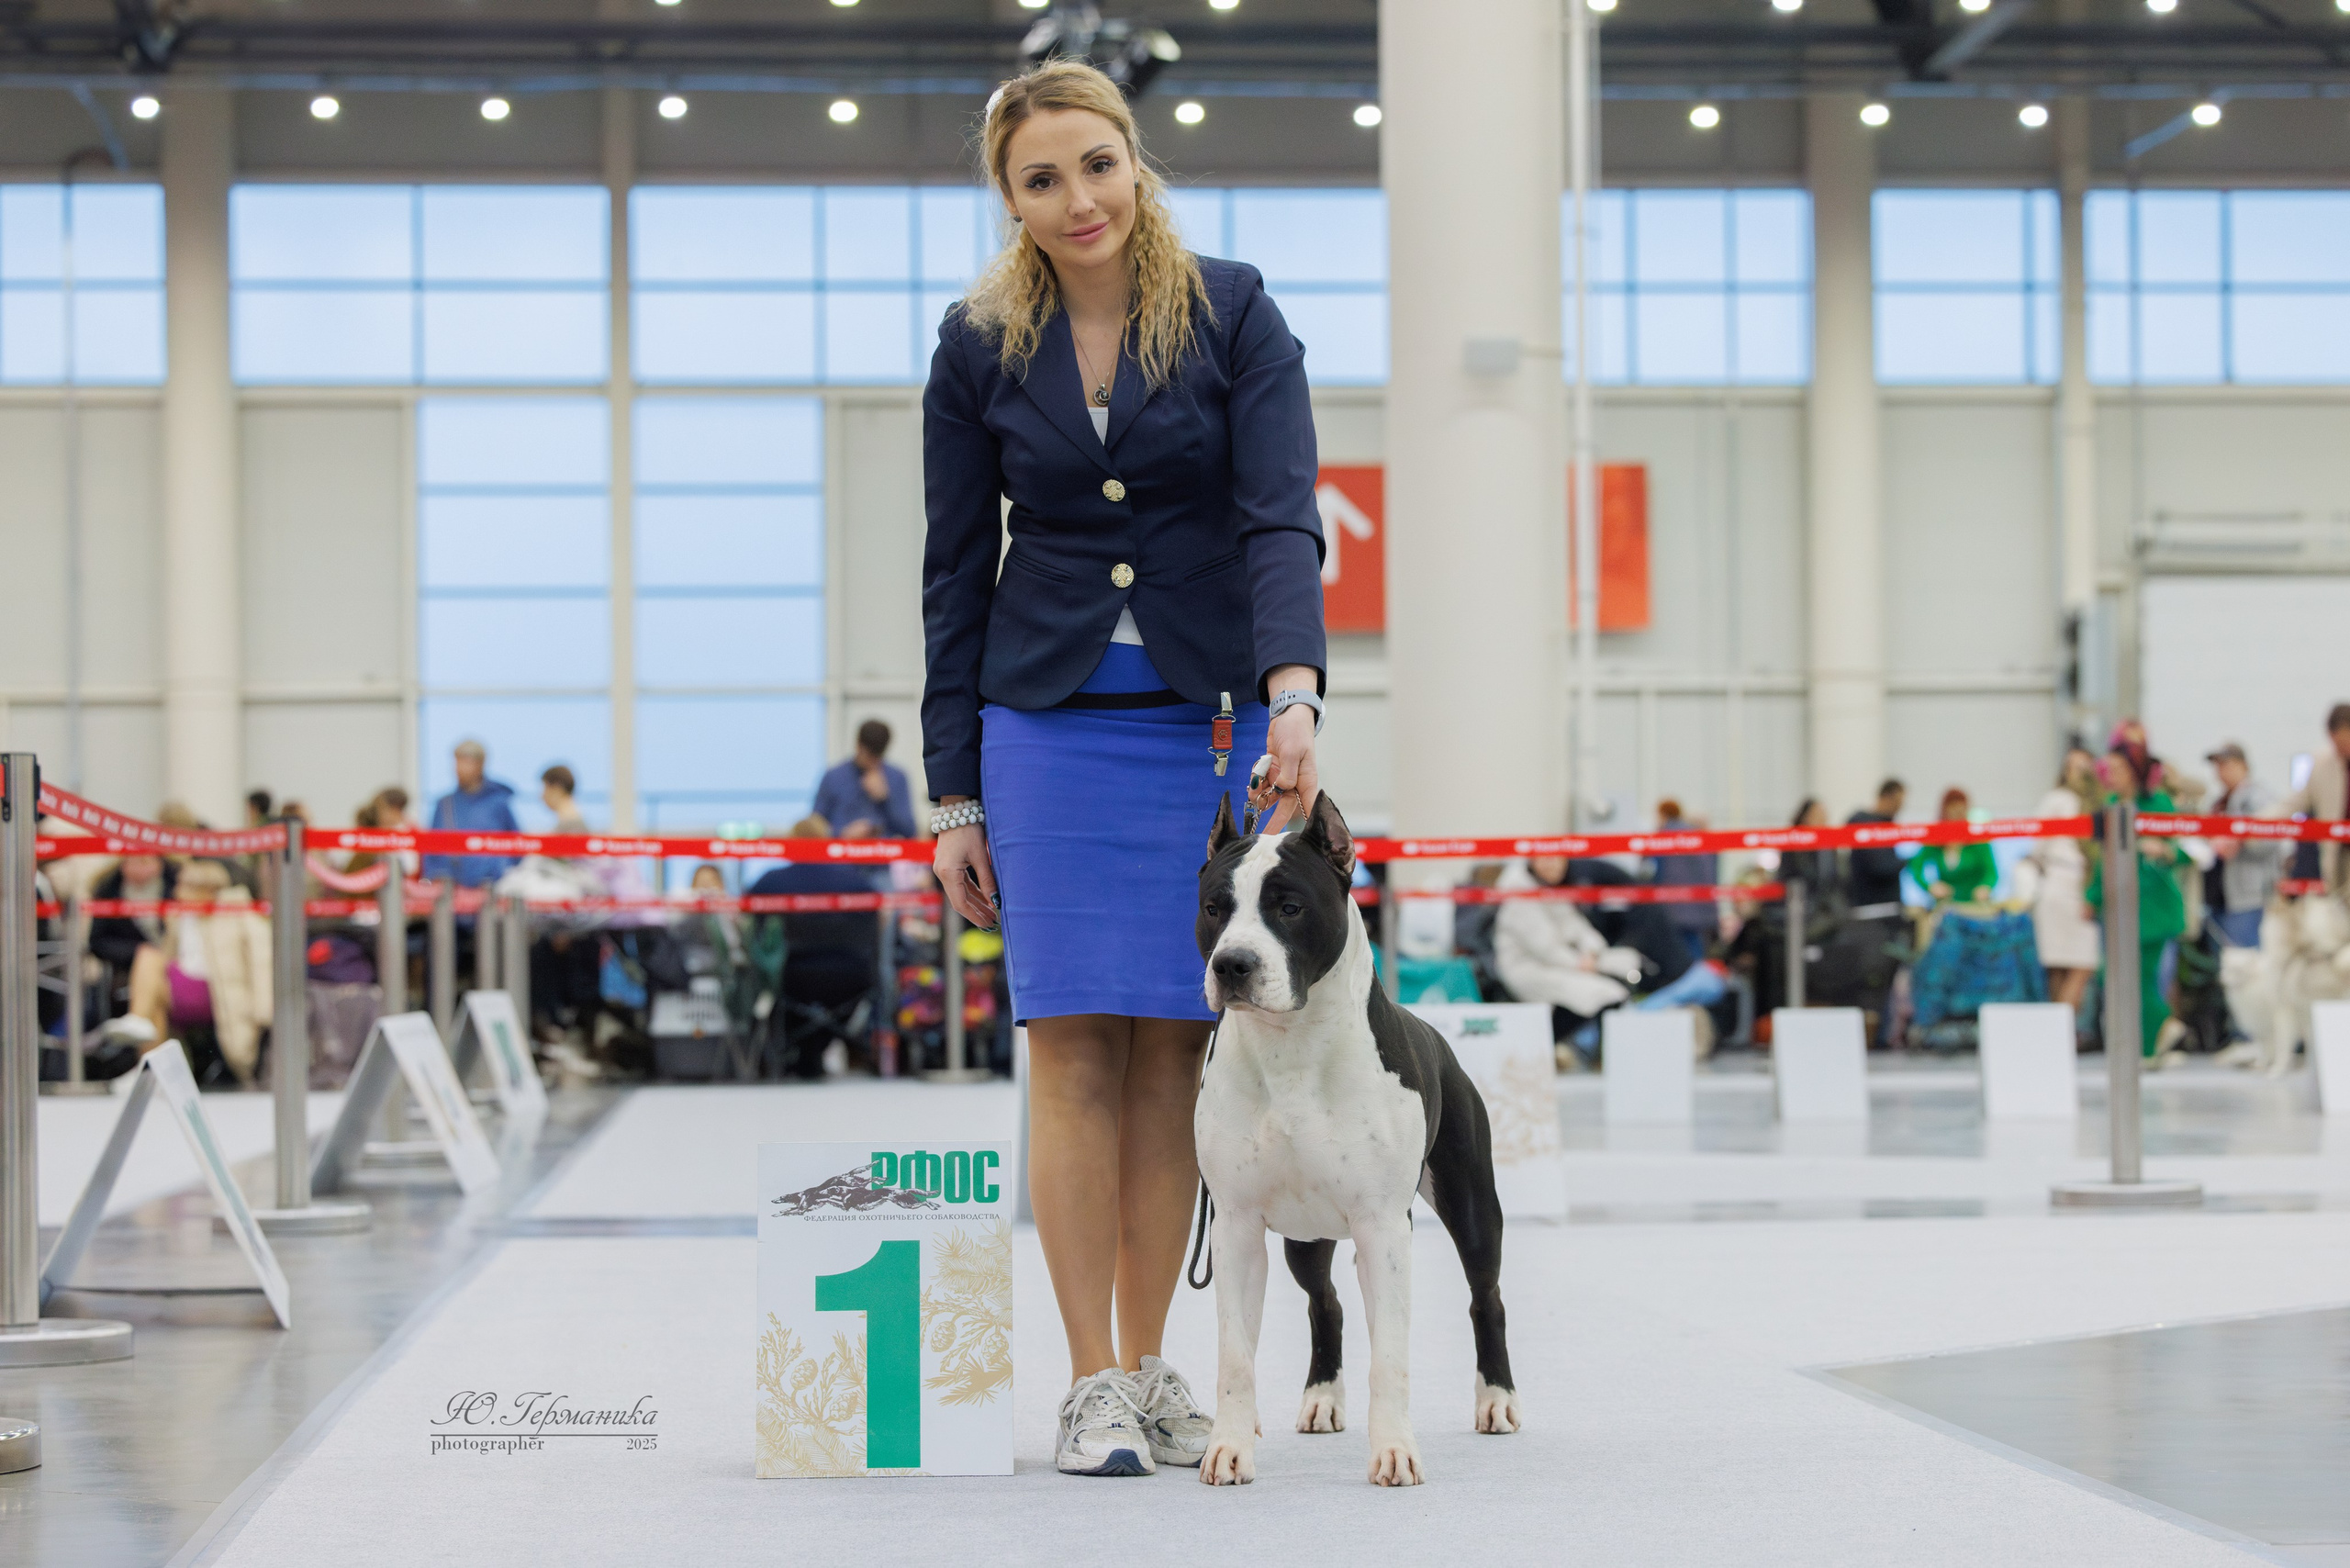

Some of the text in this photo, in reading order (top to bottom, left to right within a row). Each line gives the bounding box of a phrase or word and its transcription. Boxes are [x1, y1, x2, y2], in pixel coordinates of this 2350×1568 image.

[871, 1149, 1001, 1204] РФОС
[858, 1214, 923, 1222] ОХОТНИЧЬЕГО
[924, 1213, 1001, 1221] СОБАКОВОДСТВА
[815, 1239, 921, 1469] 1
